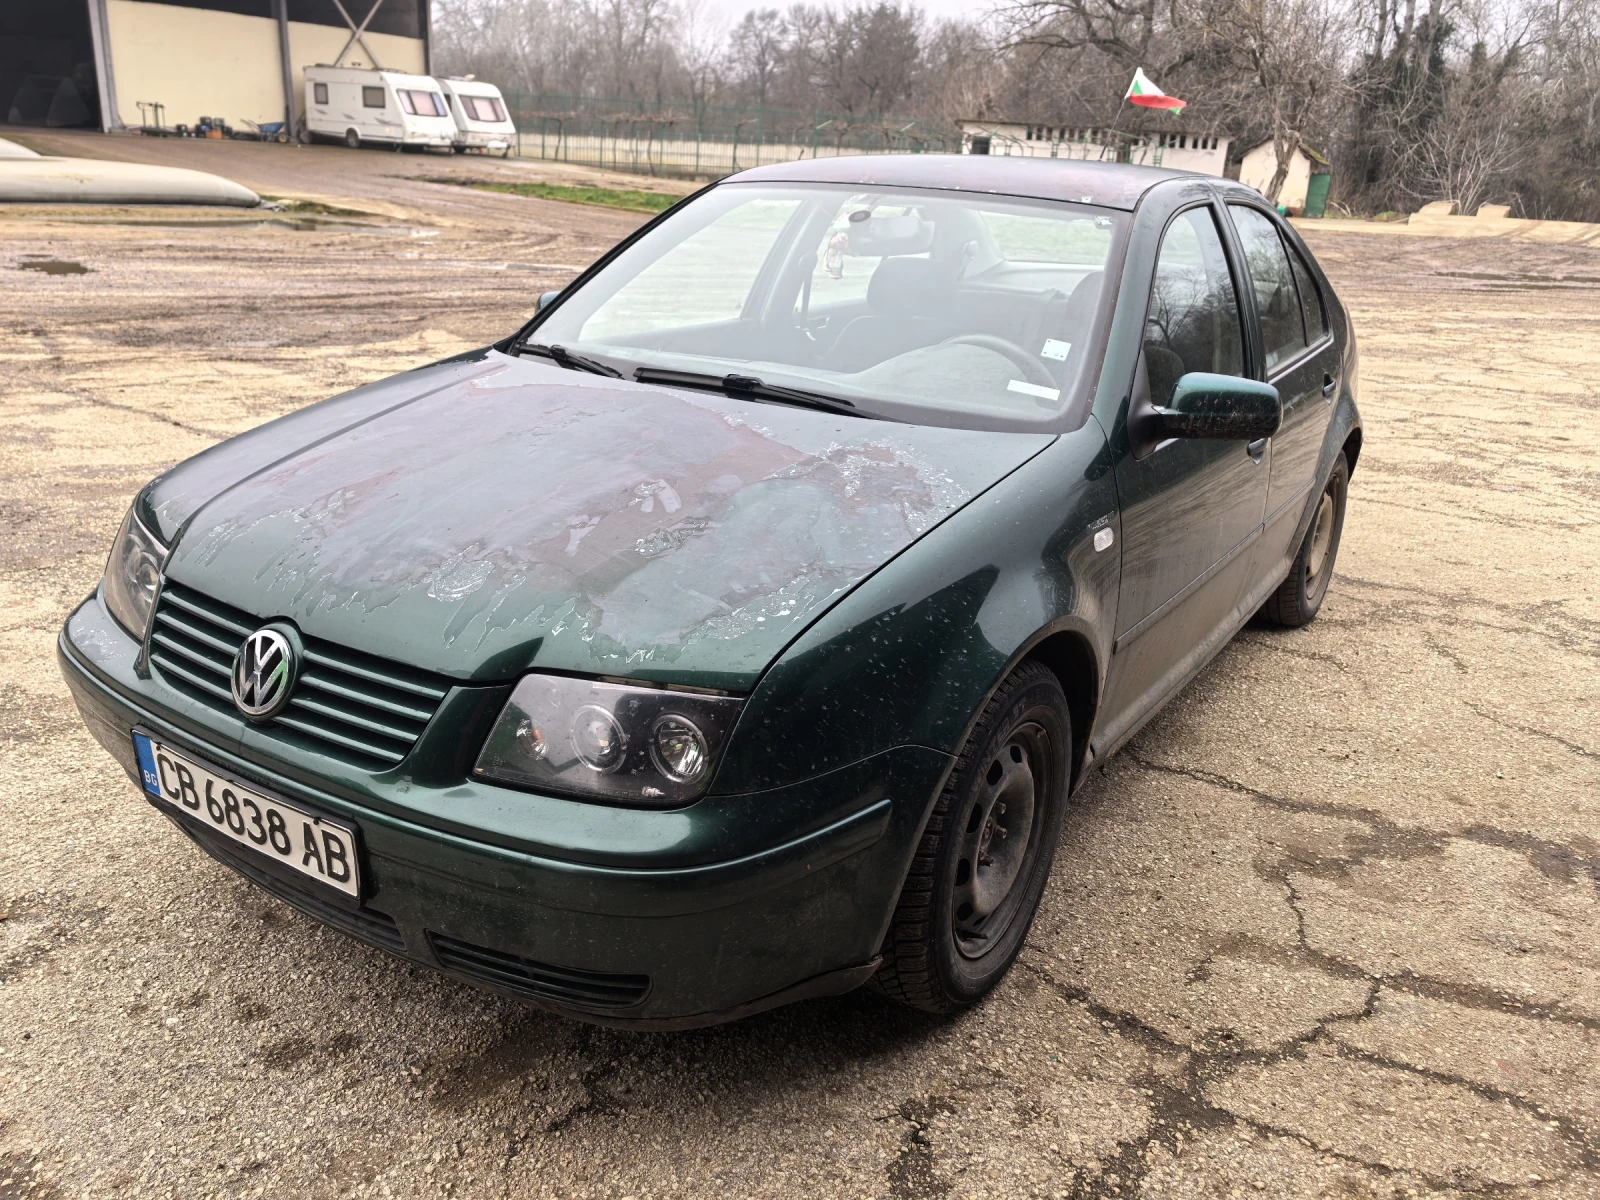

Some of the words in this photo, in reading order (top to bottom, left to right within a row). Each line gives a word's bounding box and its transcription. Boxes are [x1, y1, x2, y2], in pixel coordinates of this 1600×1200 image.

[144, 769, 158, 787] BG
[157, 753, 200, 811] CB
[205, 778, 292, 856] 6838
[302, 820, 351, 884] AB
